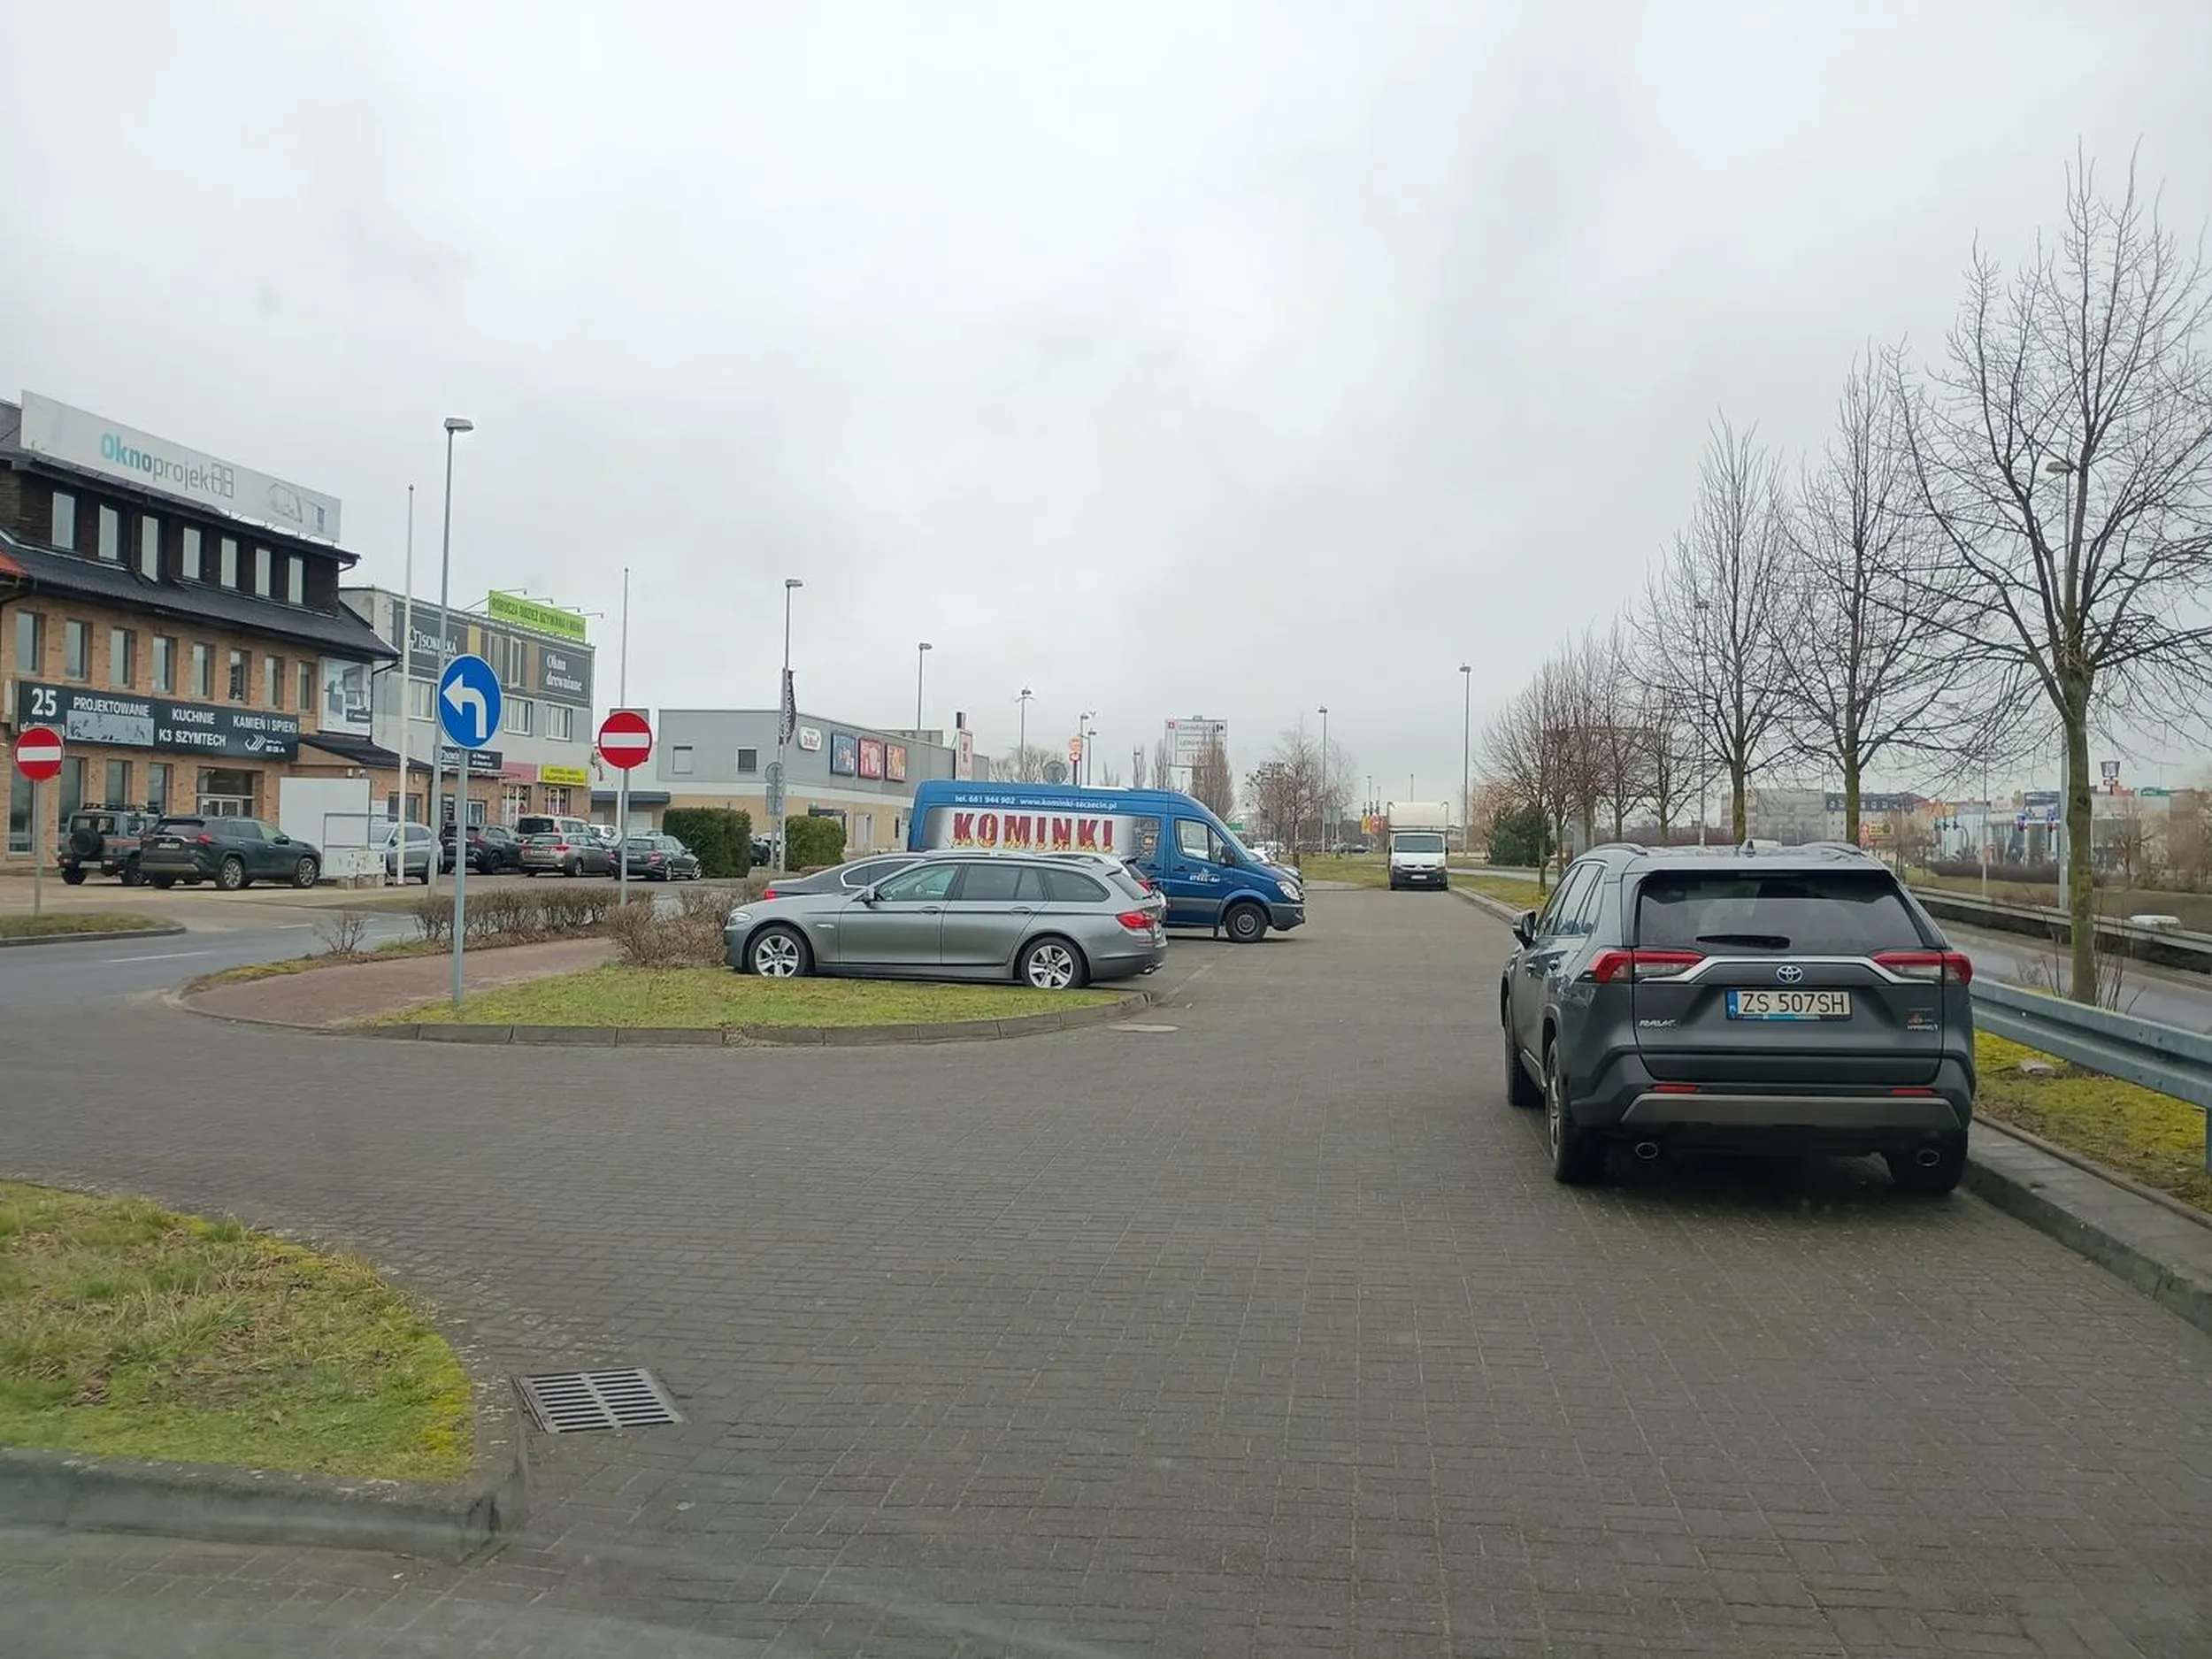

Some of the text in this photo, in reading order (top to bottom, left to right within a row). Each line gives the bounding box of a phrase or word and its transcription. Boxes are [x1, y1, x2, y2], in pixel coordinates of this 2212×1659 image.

[101, 432, 223, 496] Oknoprojekt
[547, 654, 566, 671] Okna
[547, 671, 582, 691] drewniane
[31, 687, 58, 717] 25
[73, 696, 150, 717] PROJEKTOWANIE
[172, 708, 215, 725] KUCHNIE
[233, 715, 265, 730] KAMIEŃ
[272, 719, 297, 733] SPIEKI
[158, 728, 227, 747] K3 SZYMTECH
[953, 812, 1114, 853] KOMINKI
[1742, 994, 1844, 1012] ZS 507SH
